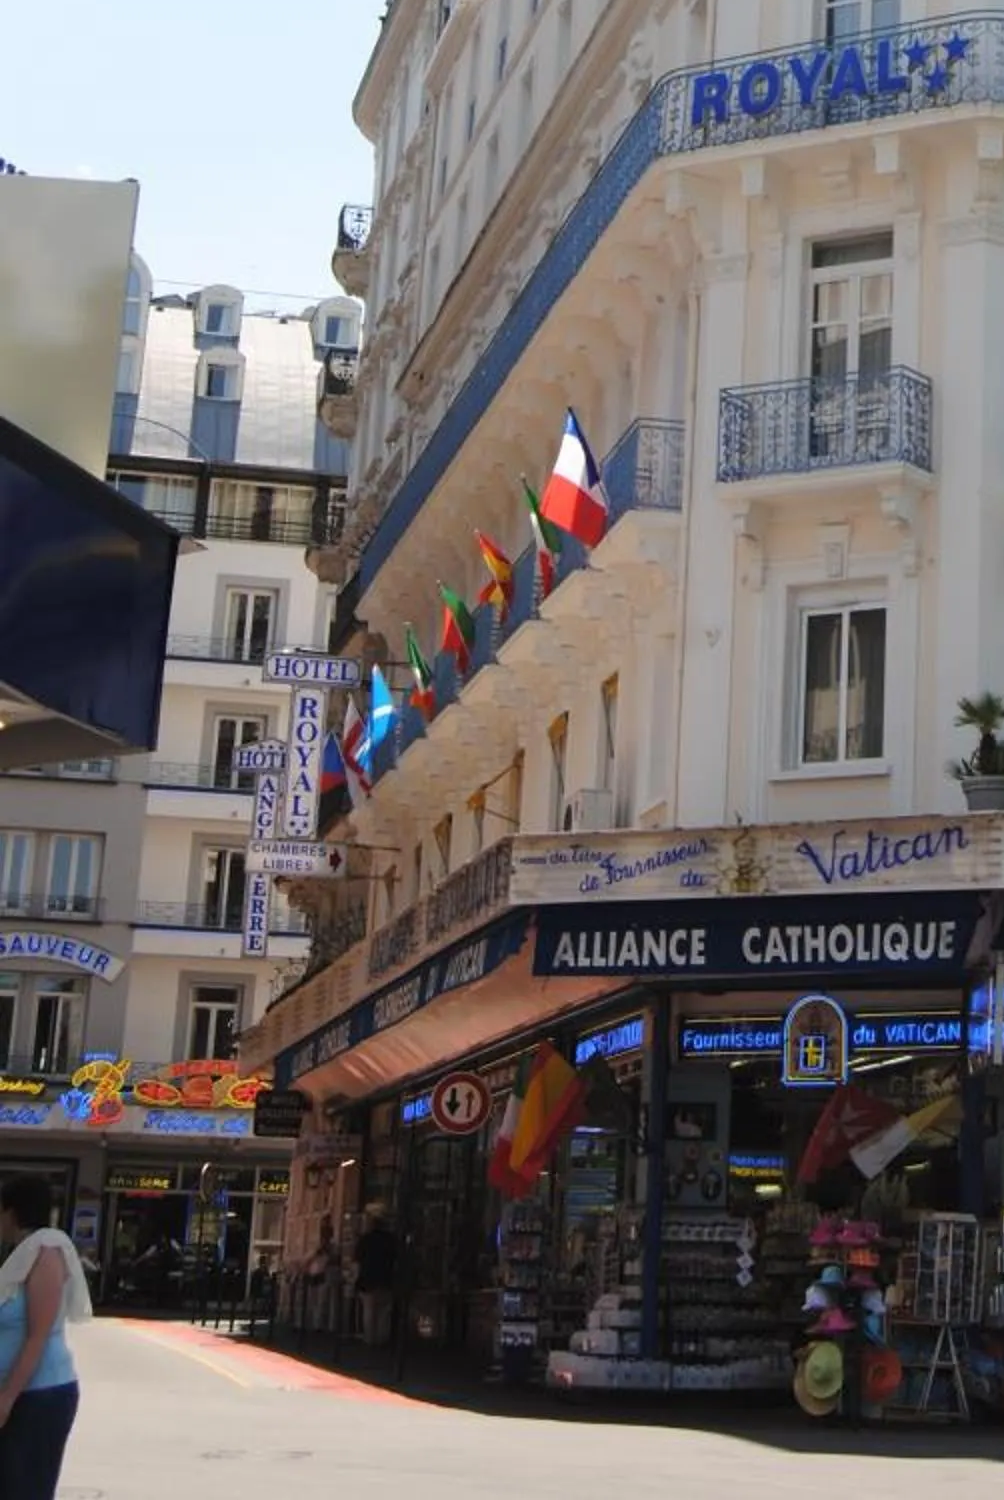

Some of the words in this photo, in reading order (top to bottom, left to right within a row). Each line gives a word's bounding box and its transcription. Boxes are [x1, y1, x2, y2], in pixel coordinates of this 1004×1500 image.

[691, 40, 907, 127] ROYAL
[273, 656, 354, 681] HOTEL
[238, 749, 286, 768] HOT
[290, 697, 318, 818] ROYAL
[251, 842, 327, 859] CHAMBRES
[262, 858, 314, 872] LIBRES
[796, 822, 970, 884] Vatican
[552, 927, 708, 968] ALLIANCE
[741, 920, 957, 966] CATHOLIQUE
[682, 1028, 782, 1049] Fournisseur
[854, 1024, 877, 1043] du
[885, 1019, 962, 1044] VATICAN
